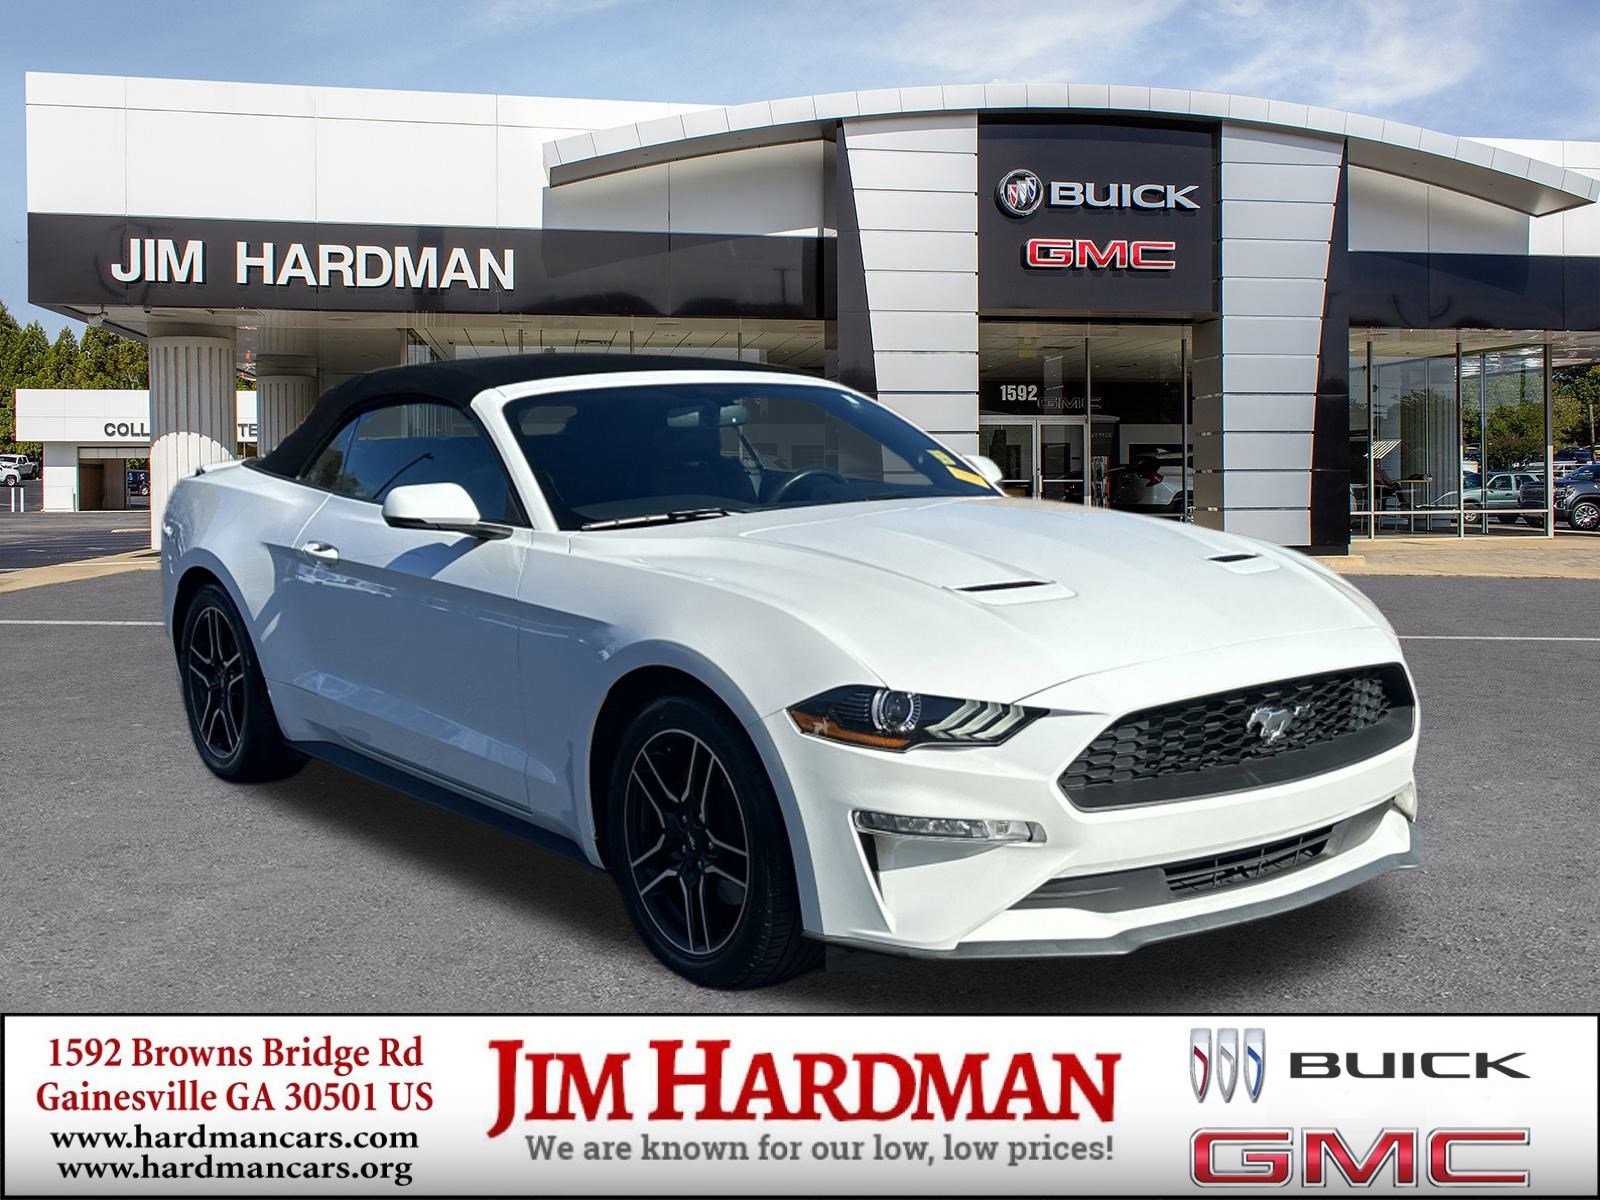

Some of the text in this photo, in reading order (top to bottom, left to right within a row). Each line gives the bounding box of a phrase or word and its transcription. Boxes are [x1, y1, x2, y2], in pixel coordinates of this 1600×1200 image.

[1050, 181, 1200, 209] BUICK
[110, 237, 515, 290] JIM HARDMAN
[1025, 237, 1177, 271] GMC
[1000, 384, 1038, 401] 1592
[1037, 396, 1102, 410] GMC
